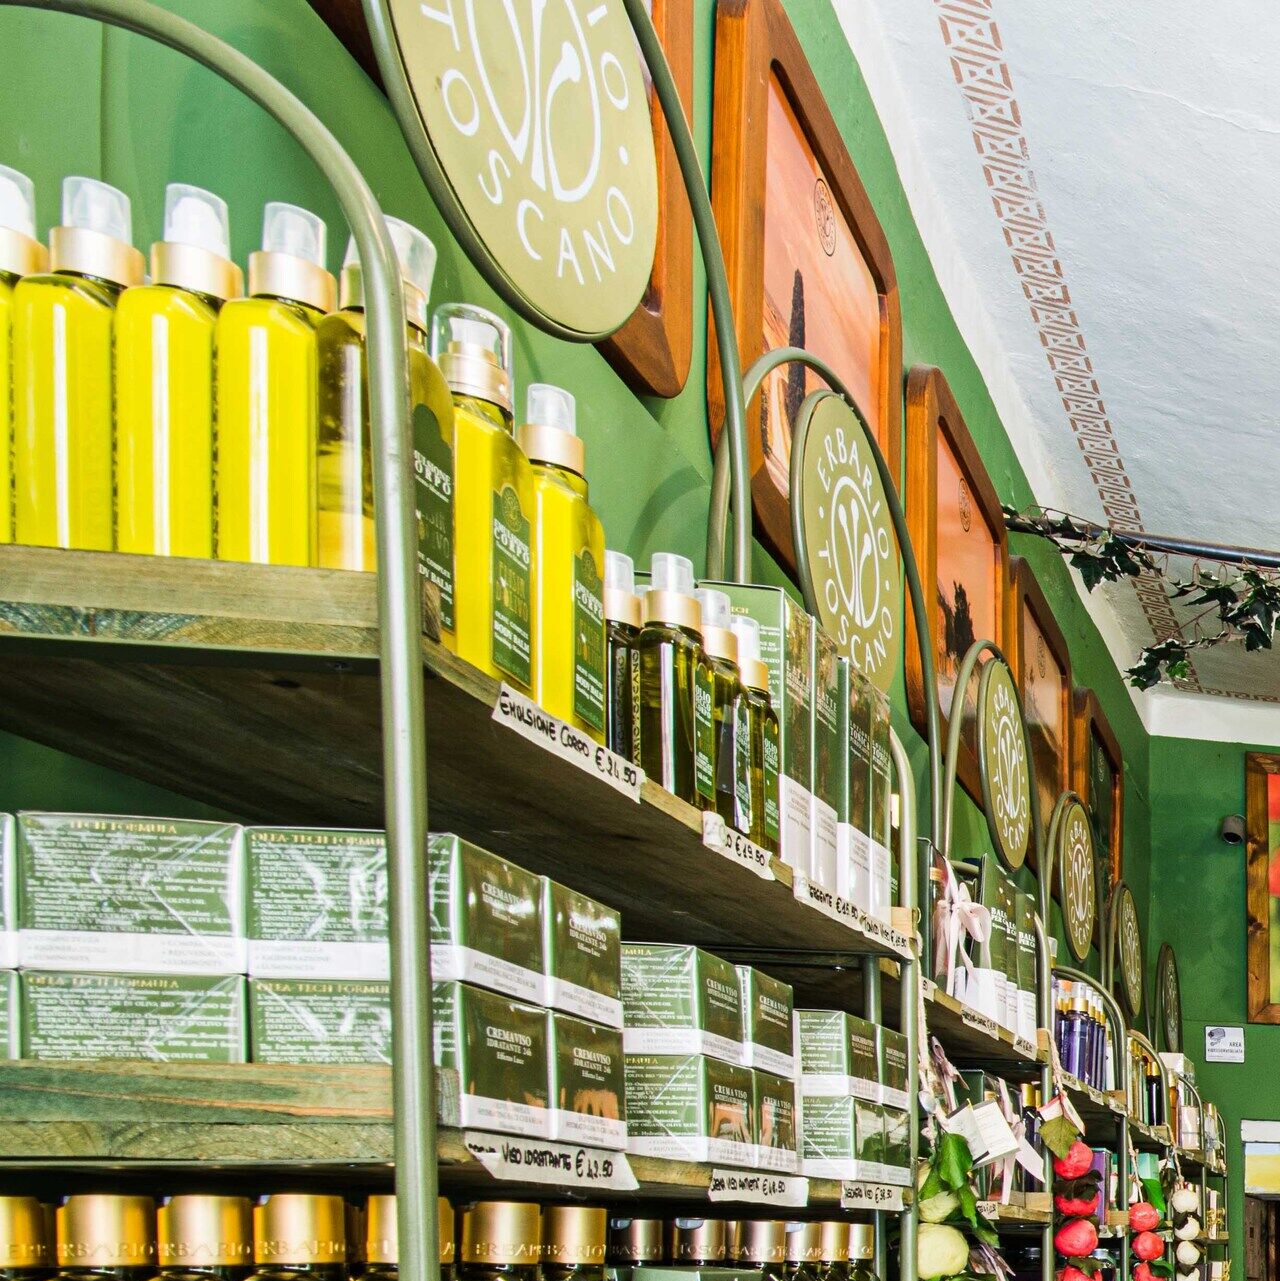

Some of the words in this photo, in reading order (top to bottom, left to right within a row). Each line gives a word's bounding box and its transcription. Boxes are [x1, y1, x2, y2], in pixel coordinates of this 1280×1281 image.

[421, 0, 634, 285] TOSCANO
[819, 427, 890, 560] ERBARIO
[818, 546, 894, 674] TOSCANO
[500, 691, 556, 741] EMULSIONE
[561, 722, 590, 759] CORPO
[992, 684, 1024, 761] ERBARIO
[993, 775, 1027, 851] TOSCANO
[502, 1141, 521, 1165] VISO
